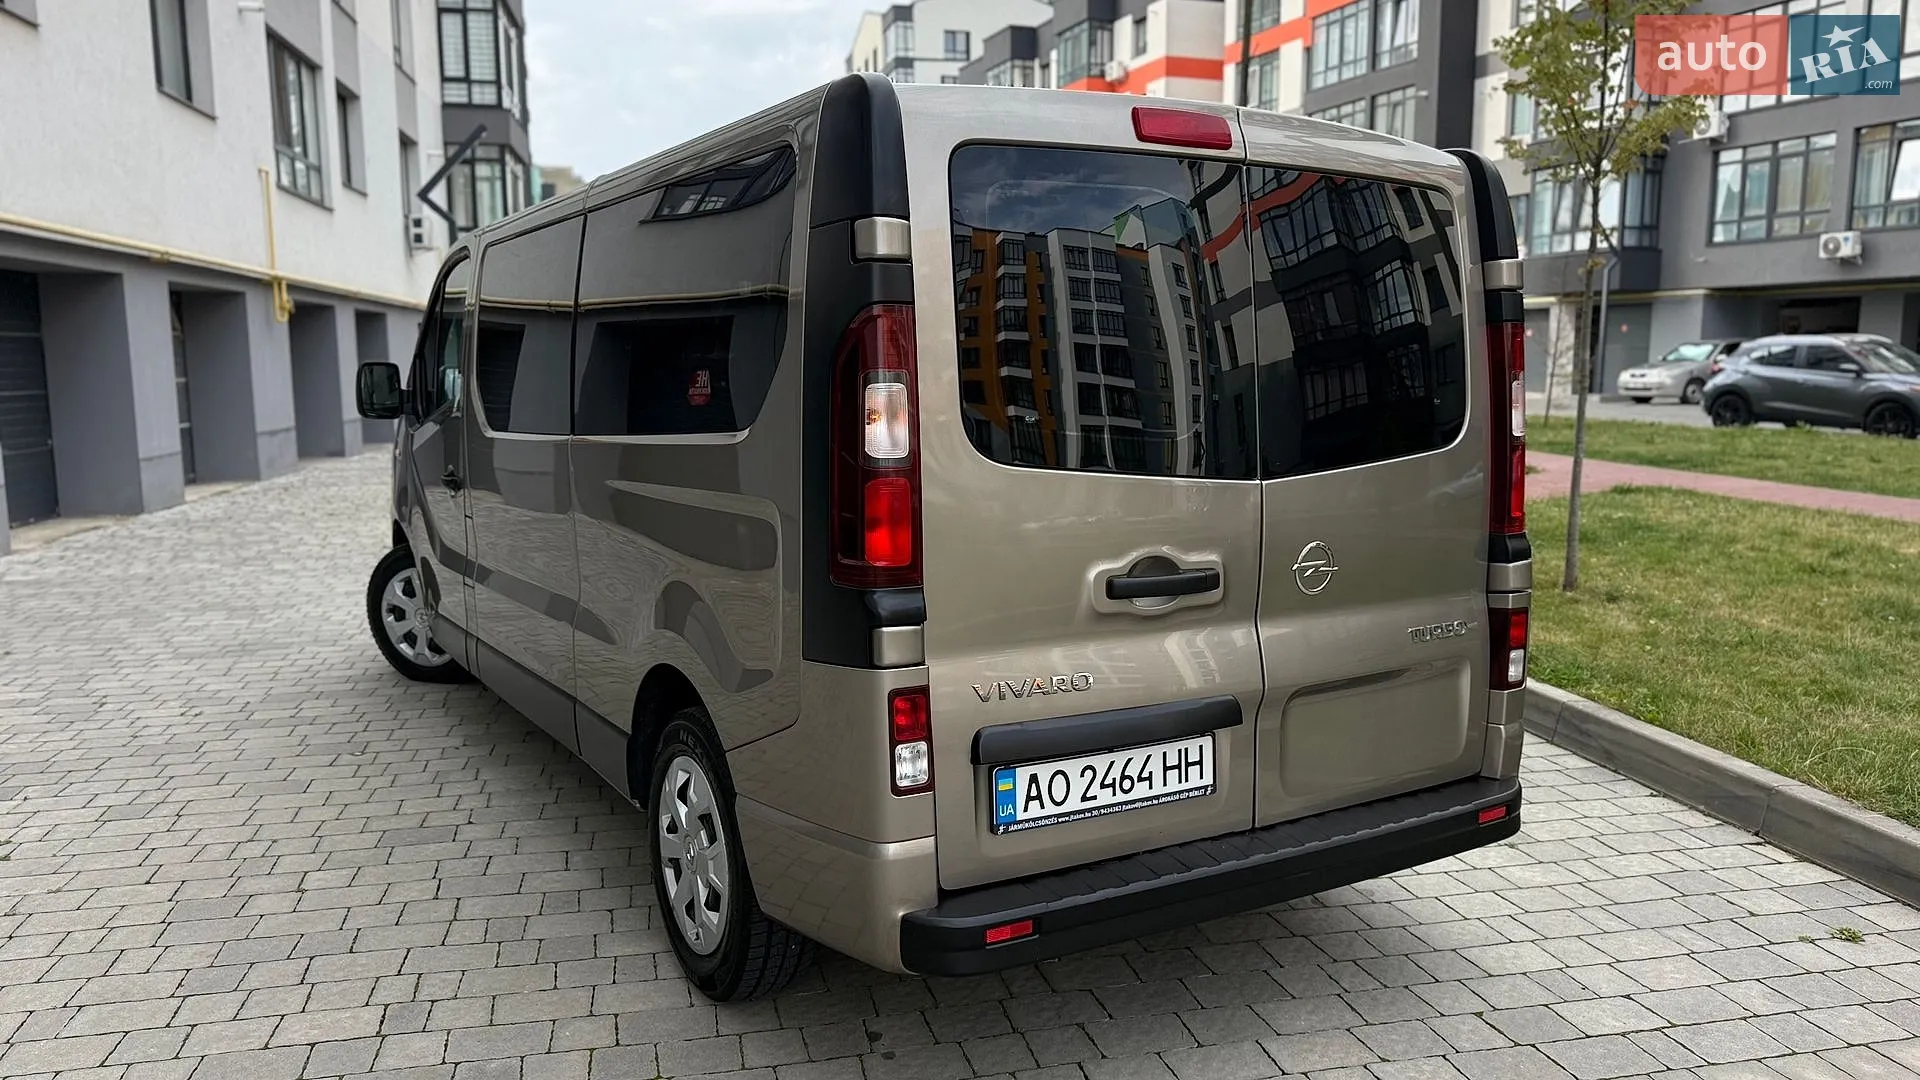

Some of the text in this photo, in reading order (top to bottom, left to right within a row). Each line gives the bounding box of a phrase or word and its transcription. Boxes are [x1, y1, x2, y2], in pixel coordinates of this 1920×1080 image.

[971, 671, 1094, 702] VIVARO
[1023, 744, 1204, 813] AO 2464 HH
[999, 805, 1014, 817] UA
